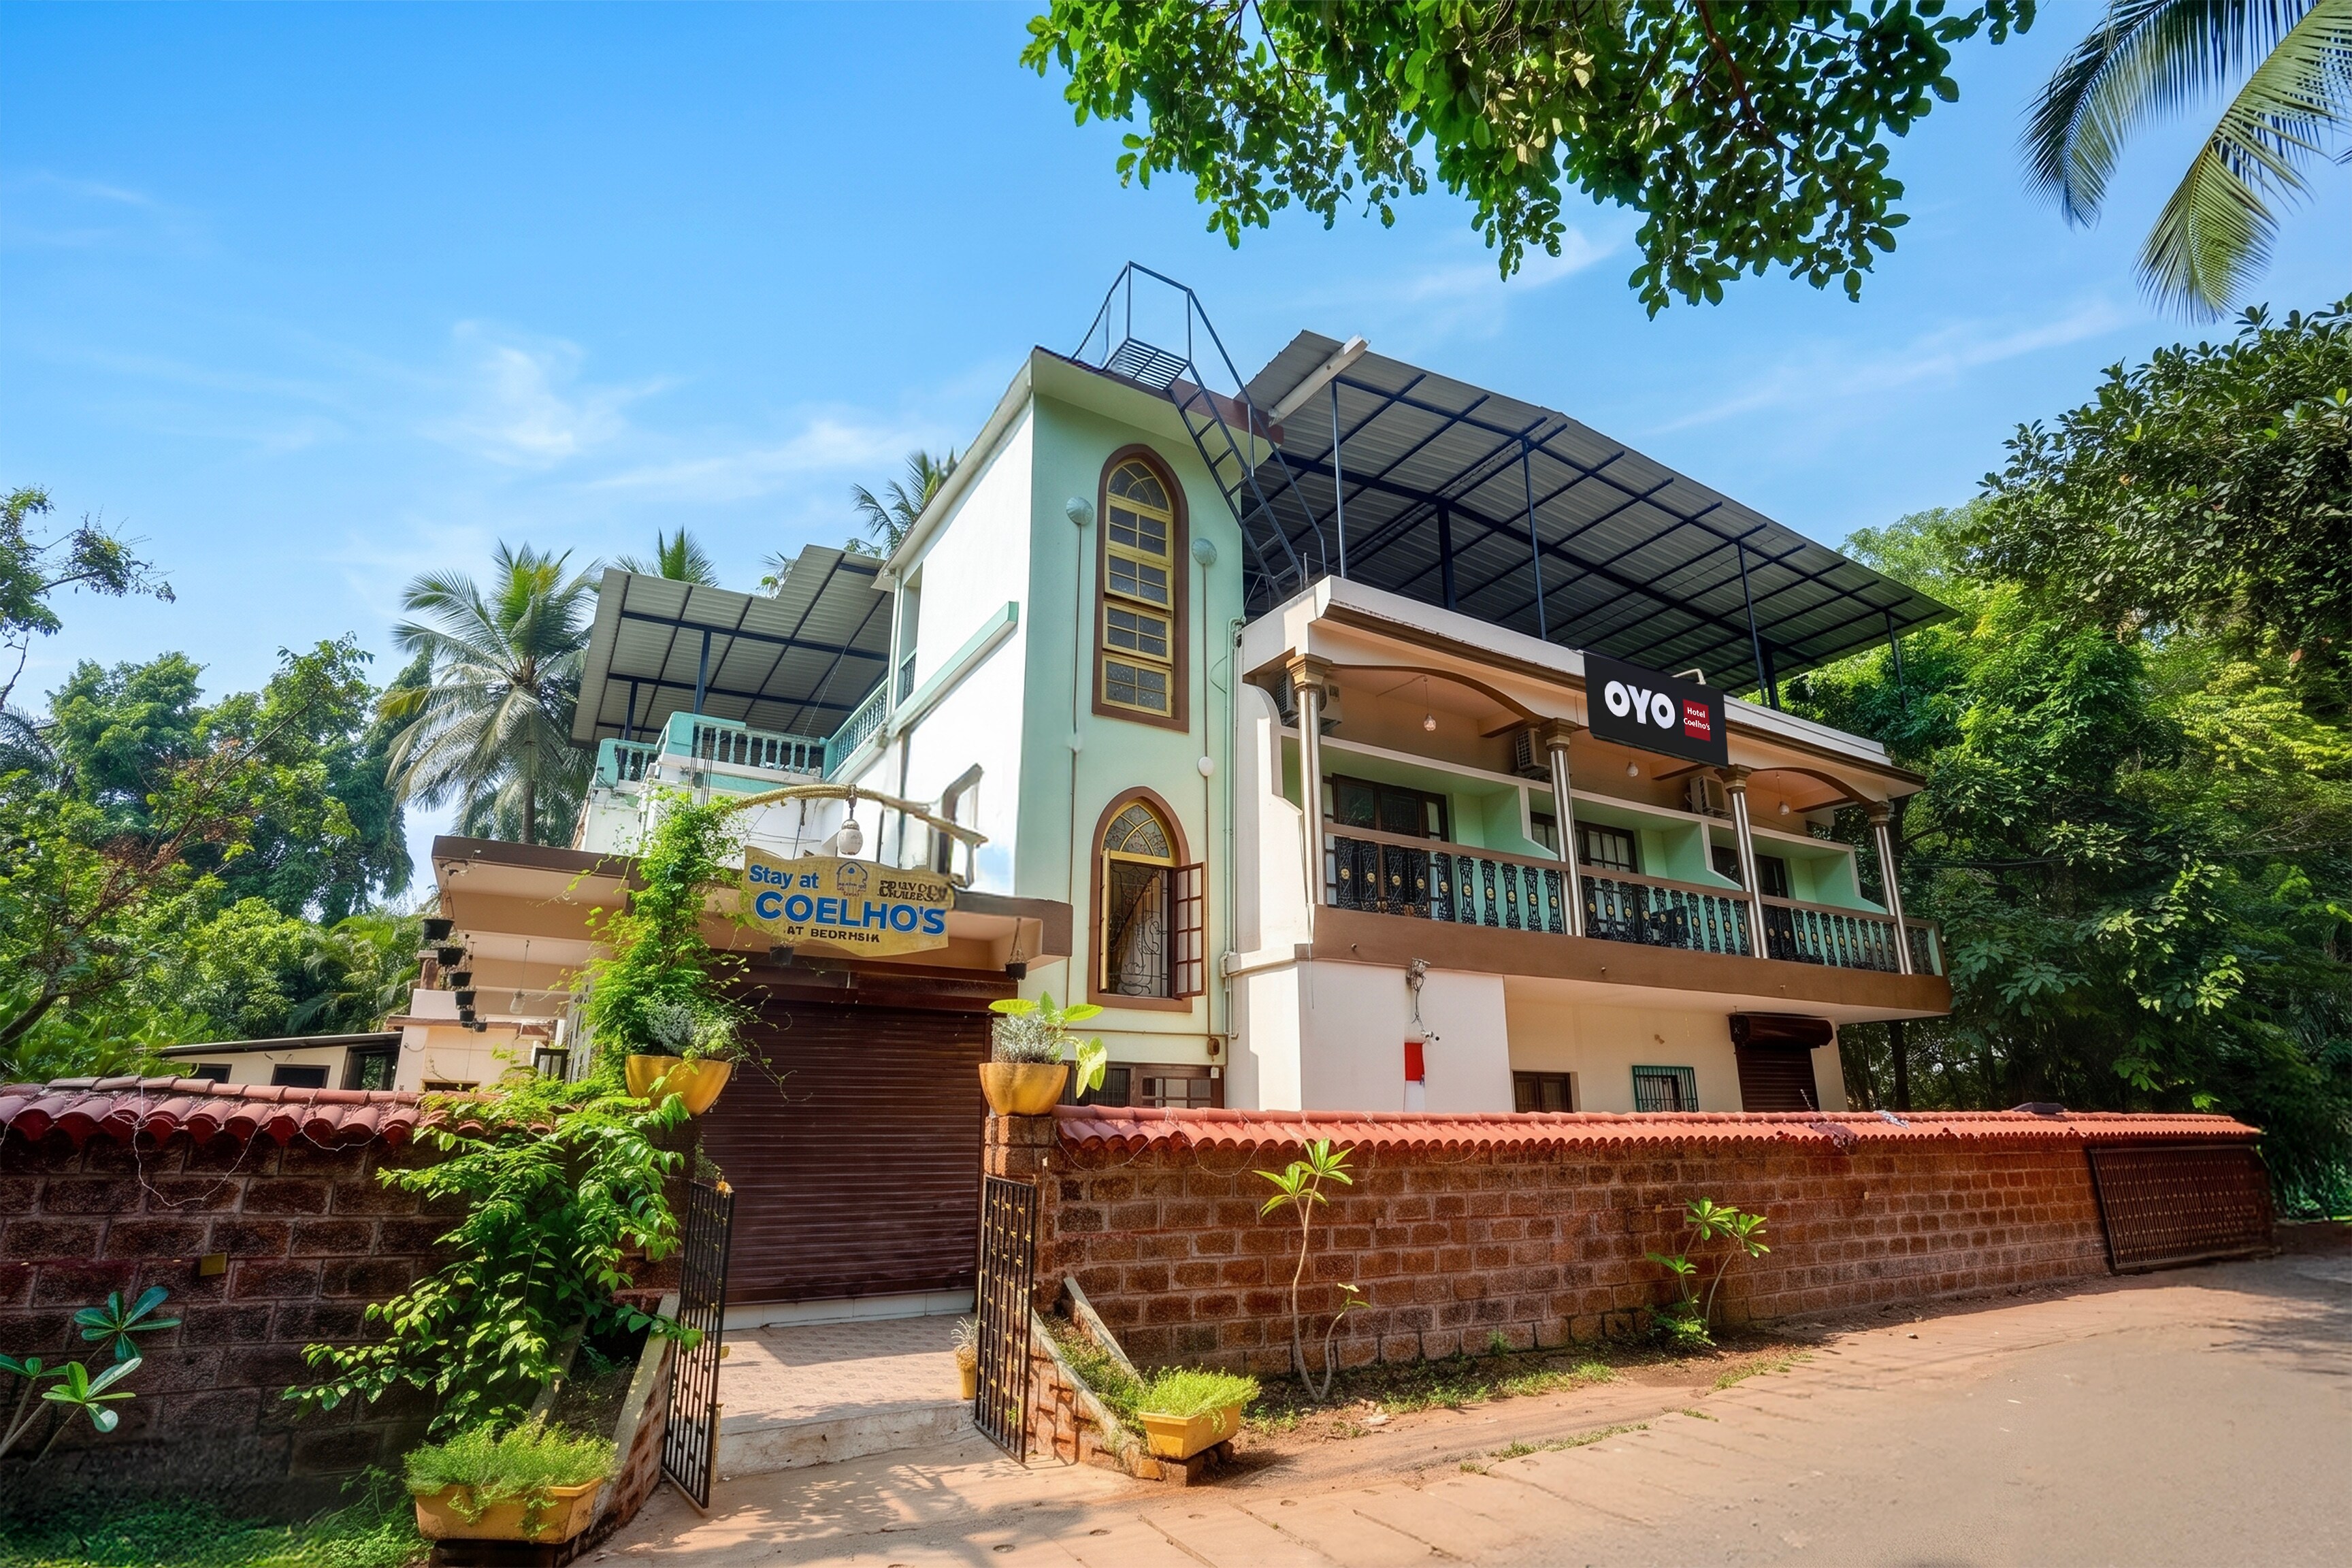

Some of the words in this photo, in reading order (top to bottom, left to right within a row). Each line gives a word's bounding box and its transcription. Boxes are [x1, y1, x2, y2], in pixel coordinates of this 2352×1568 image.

[1604, 680, 1676, 730] OYO
[1687, 706, 1705, 718] Hotel
[1683, 717, 1711, 731] Coelho's
[749, 864, 794, 890] Stay
[799, 872, 820, 889] at
[755, 890, 946, 935] COELHO'S
[787, 926, 804, 936] AT
